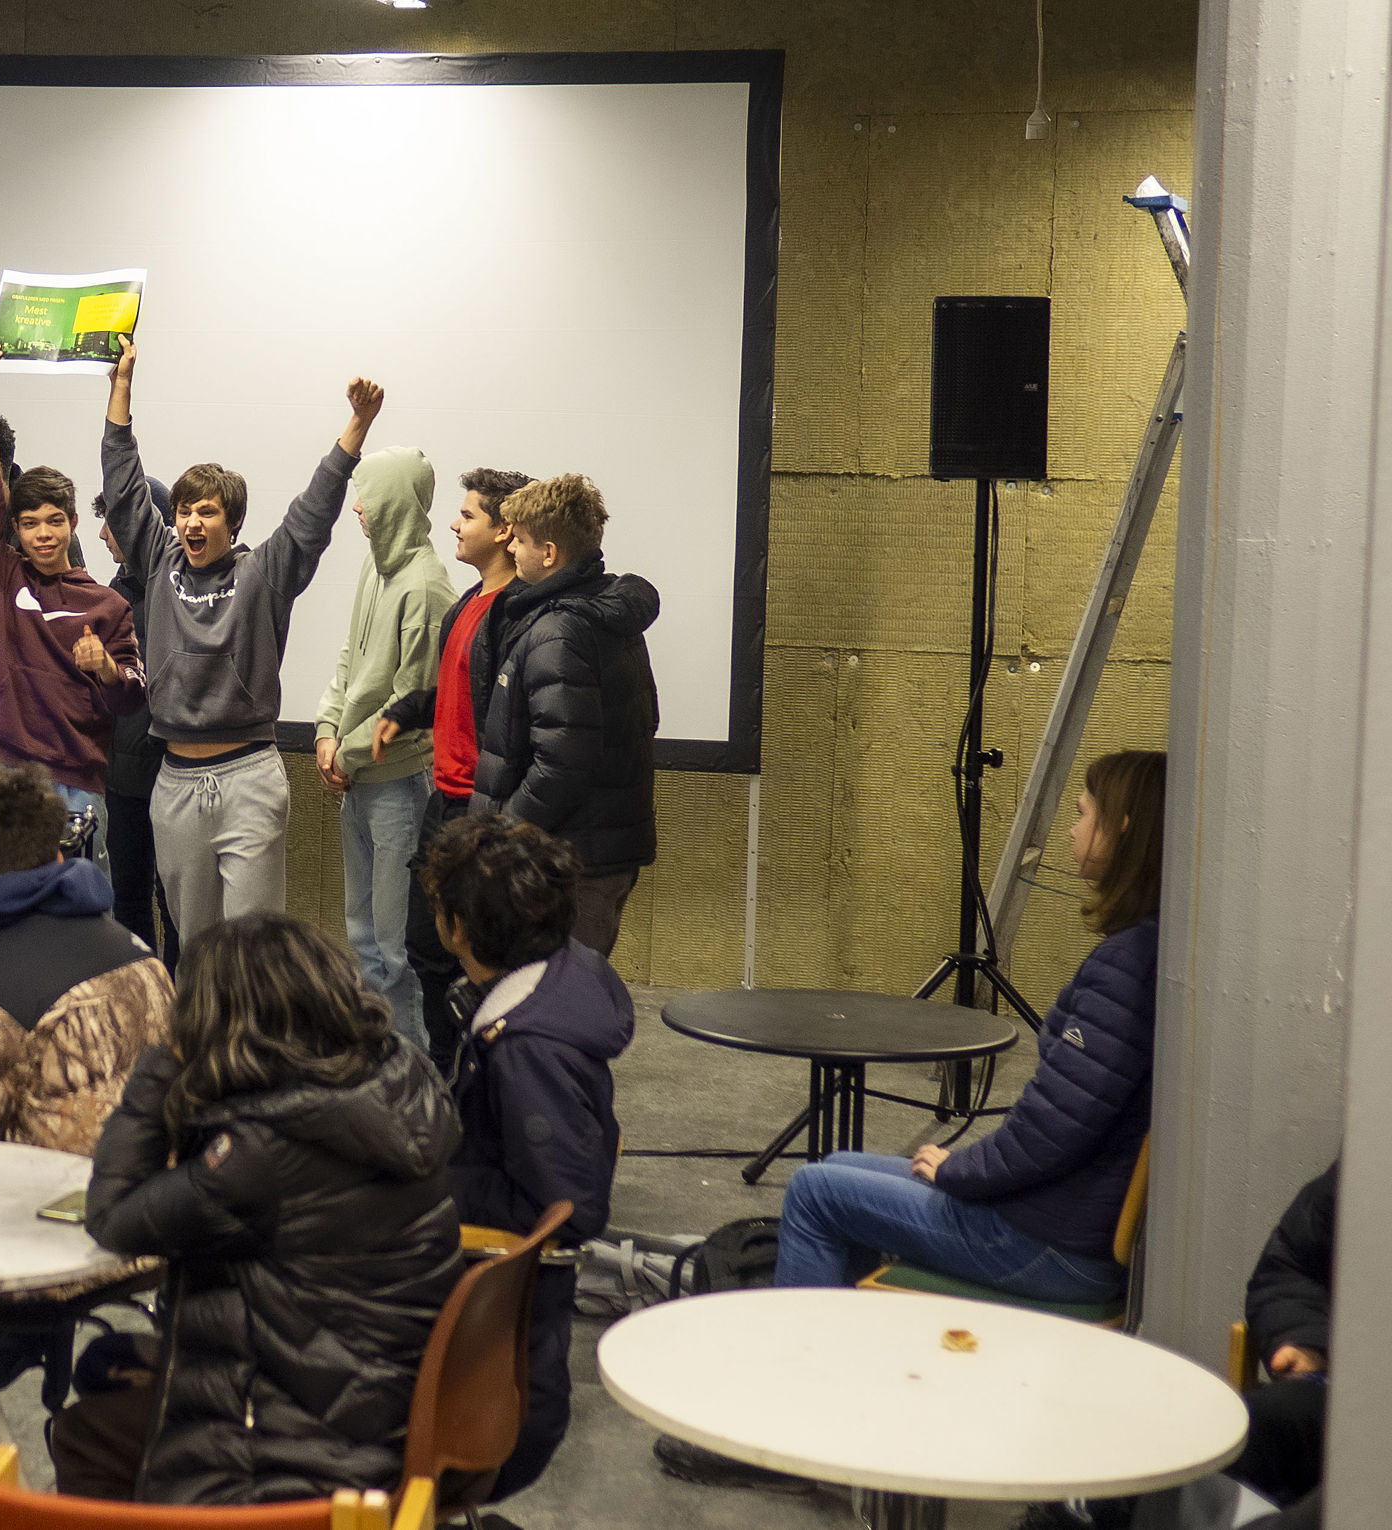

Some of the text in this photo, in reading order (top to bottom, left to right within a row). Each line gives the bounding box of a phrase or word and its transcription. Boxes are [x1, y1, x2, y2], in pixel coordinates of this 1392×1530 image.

[24, 304, 49, 316] Most
[14, 314, 52, 327] kreative
[170, 570, 238, 607] Champio
